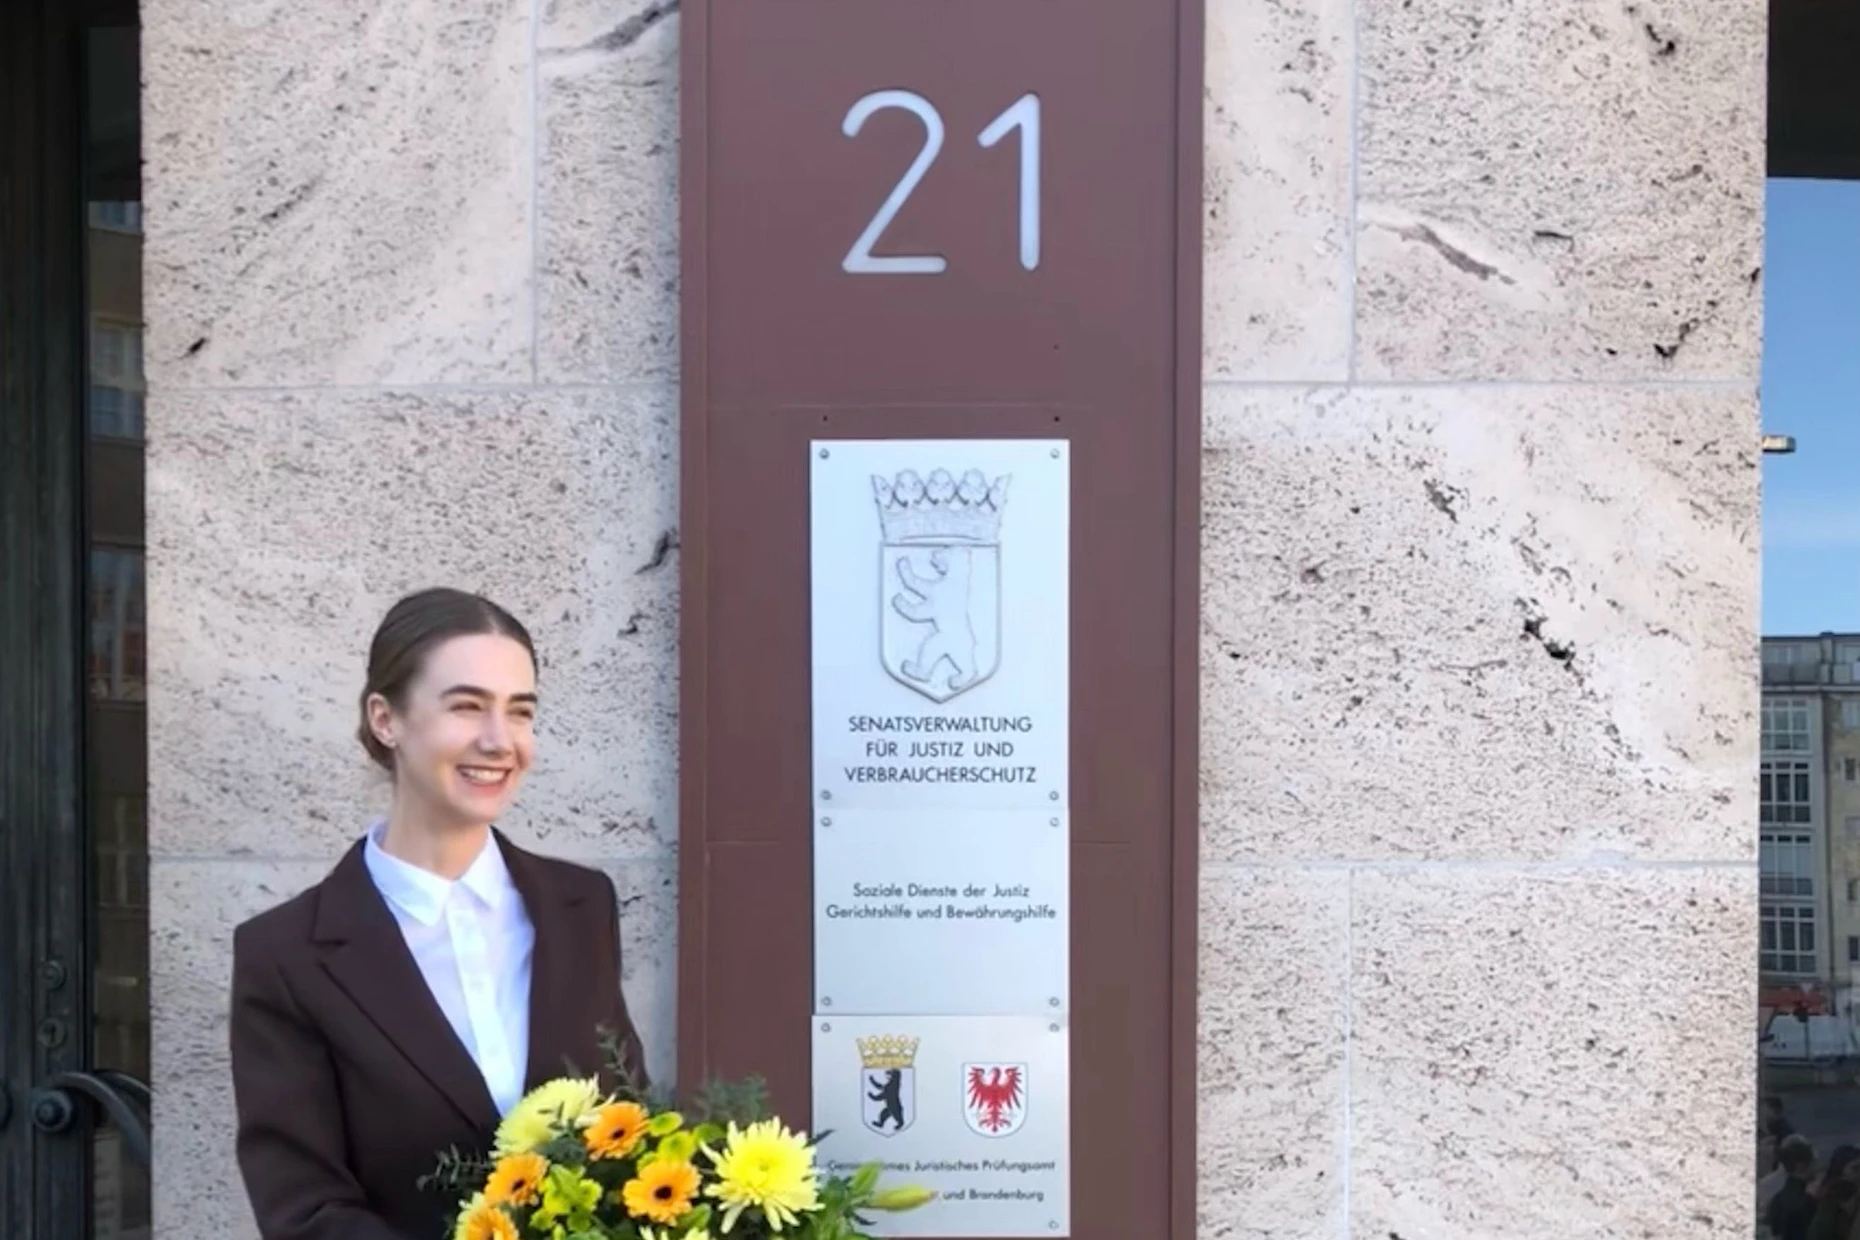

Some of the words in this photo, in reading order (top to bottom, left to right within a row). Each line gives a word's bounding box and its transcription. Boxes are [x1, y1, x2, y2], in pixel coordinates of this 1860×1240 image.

[842, 90, 1040, 273] 21
[848, 716, 1033, 733] SENATSVERWALTUNG
[866, 739, 898, 758] FÜR
[908, 741, 964, 758] JUSTIZ
[974, 741, 1014, 758] UND
[844, 766, 1037, 784] VERBRAUCHERSCHUTZ
[853, 882, 903, 898] Soziale
[907, 882, 958, 898] Dienste
[963, 882, 987, 898] der
[992, 883, 1030, 898] Justiz
[825, 904, 912, 919] Gerichtshilfe
[916, 904, 942, 919] und
[946, 904, 1057, 923] Bewährungshilfe
[914, 1160, 979, 1172] Juristisches
[982, 1159, 1056, 1174] Prüfungsamt
[942, 1188, 966, 1201] und
[969, 1188, 1044, 1203] Brandenburg
